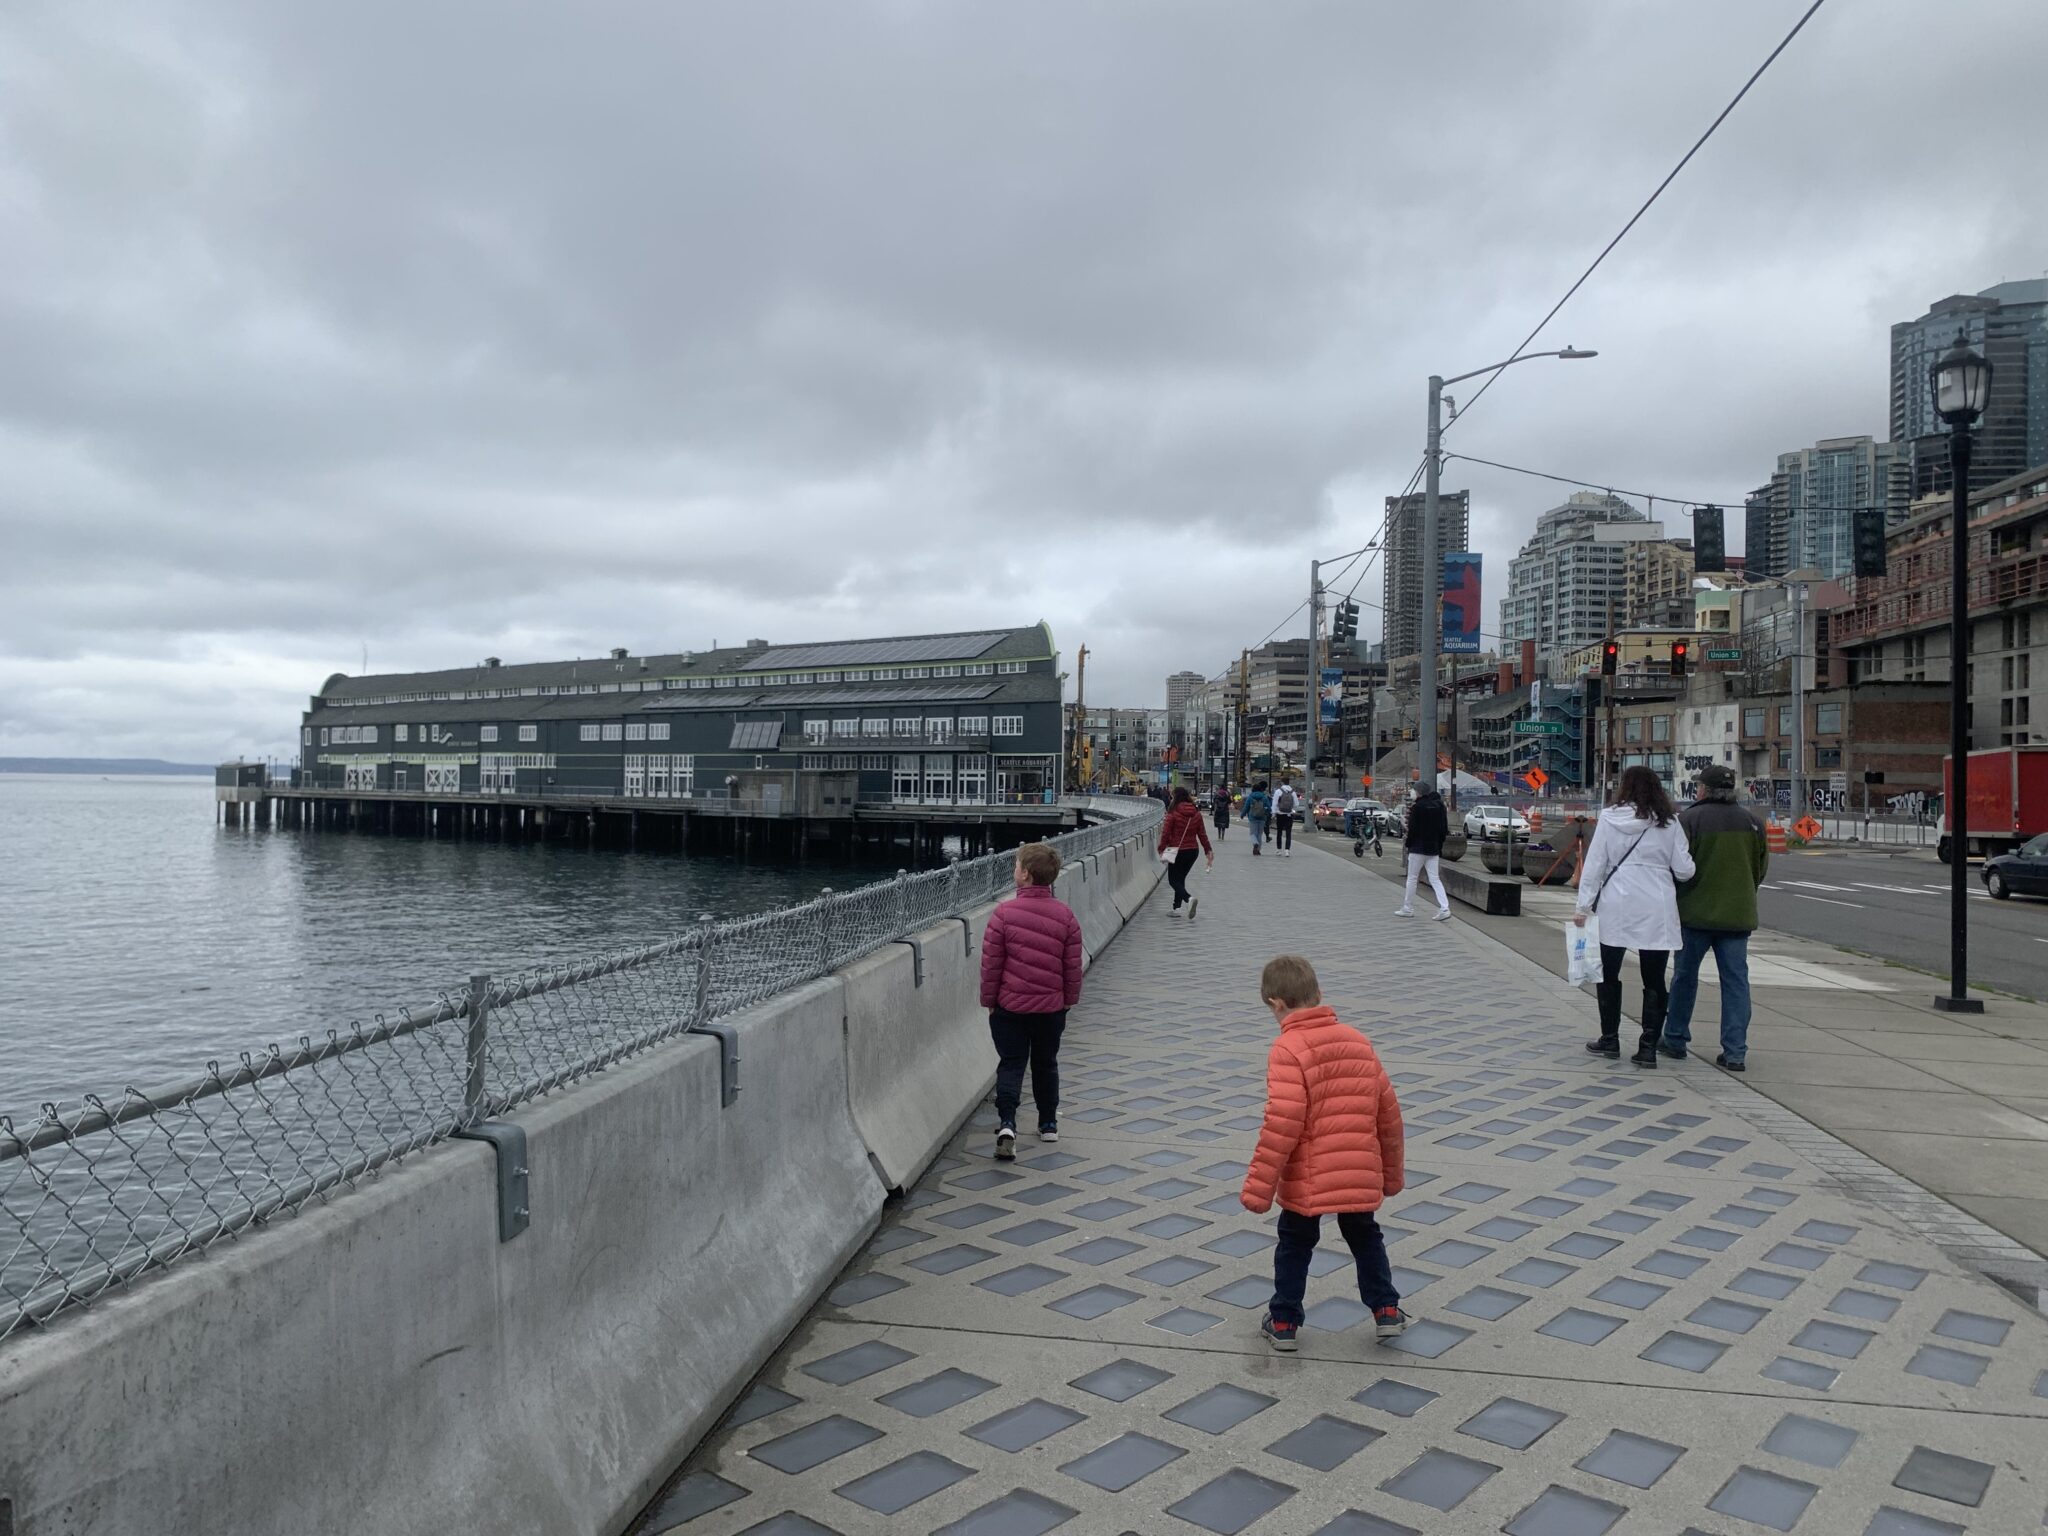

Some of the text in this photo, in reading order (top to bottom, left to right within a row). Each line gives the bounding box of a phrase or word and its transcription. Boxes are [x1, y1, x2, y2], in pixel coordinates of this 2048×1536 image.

[1710, 651, 1739, 659] Union St
[1520, 722, 1545, 732] Union
